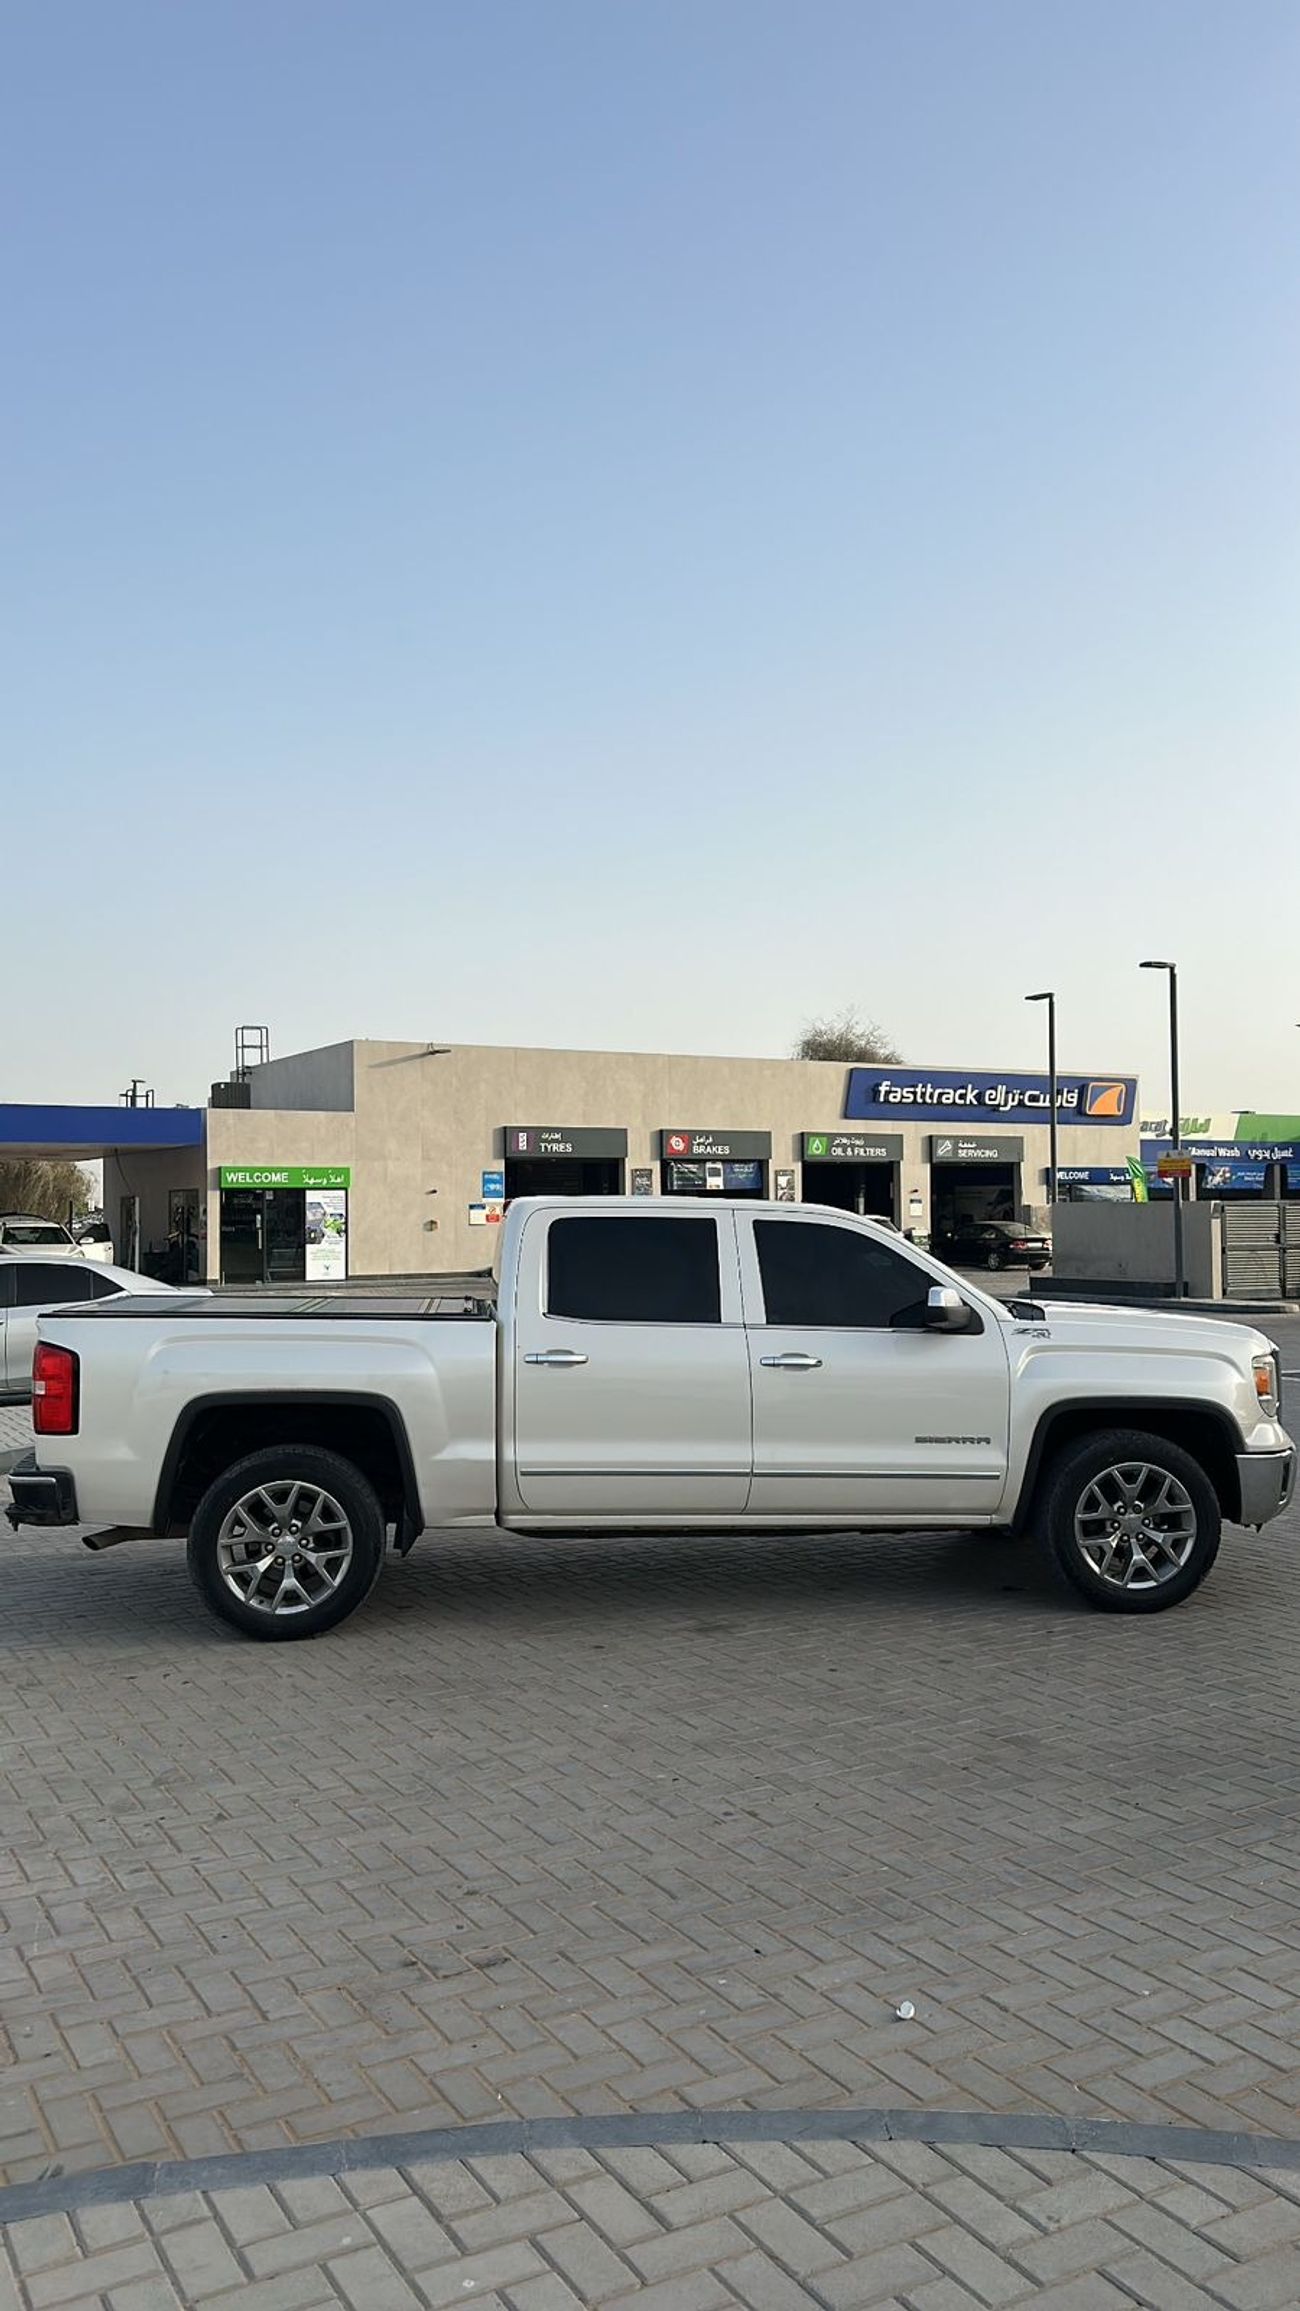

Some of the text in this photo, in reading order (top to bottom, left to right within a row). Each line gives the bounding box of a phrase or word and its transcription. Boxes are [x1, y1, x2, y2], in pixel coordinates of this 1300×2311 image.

[878, 1080, 978, 1106] fasttrack
[540, 1142, 573, 1153] TYRES
[692, 1145, 731, 1155] BRAKES
[831, 1146, 887, 1157] OIL & FILTERS
[1218, 1146, 1241, 1157] Wash
[958, 1149, 998, 1158] SERVICING
[225, 1171, 289, 1184] WELCOME
[914, 1435, 992, 1445] SIERRA
